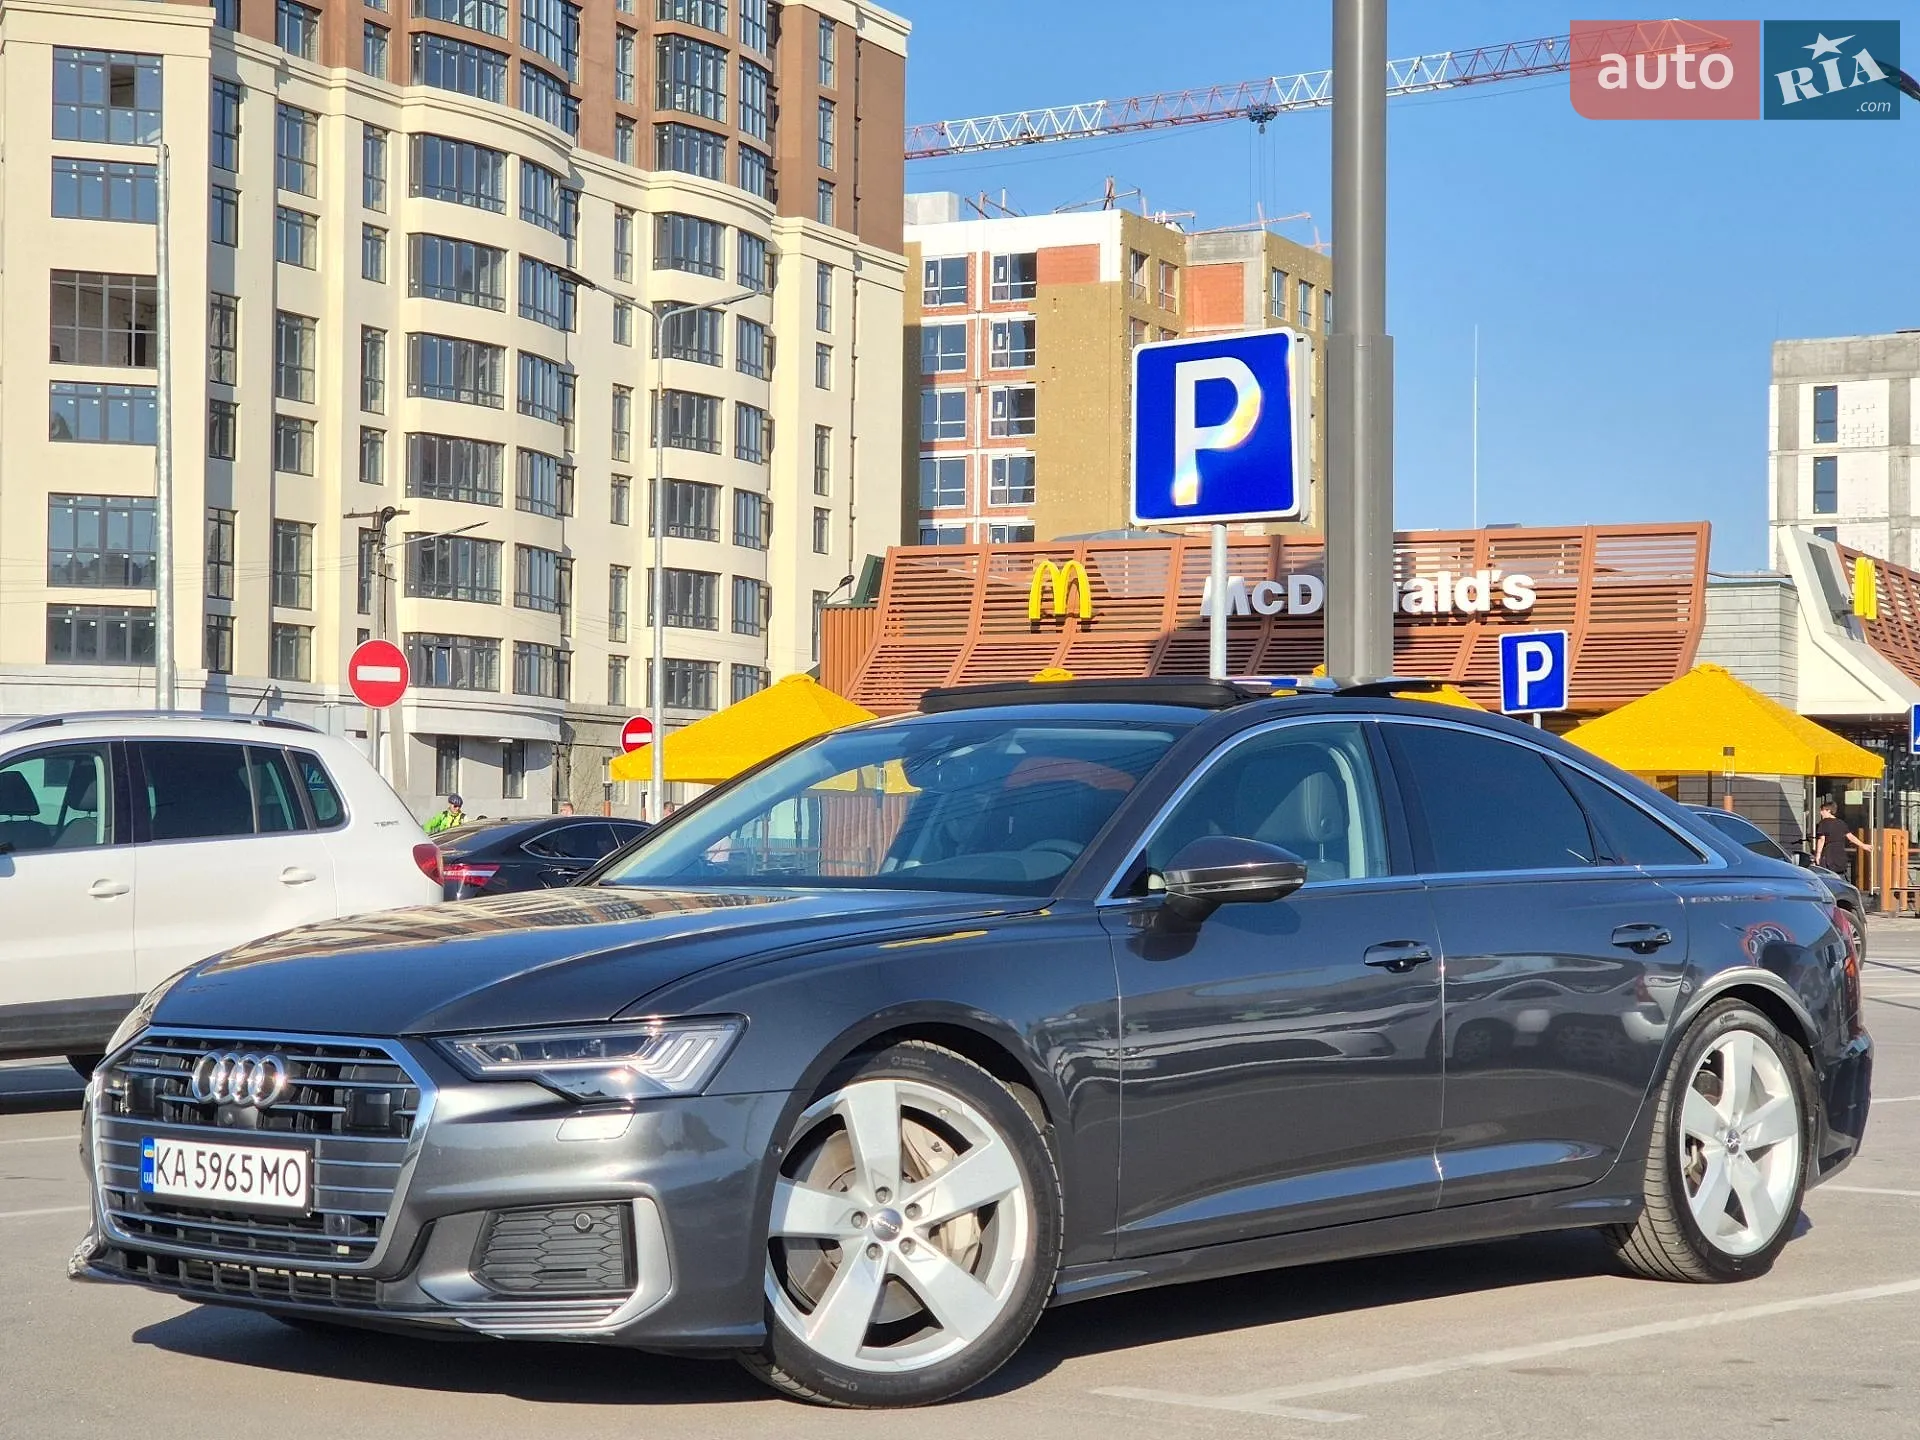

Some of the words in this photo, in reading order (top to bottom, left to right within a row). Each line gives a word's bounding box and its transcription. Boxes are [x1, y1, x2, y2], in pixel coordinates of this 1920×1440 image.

[1174, 356, 1262, 507] P
[1199, 570, 1537, 617] McDald's
[1517, 641, 1554, 706] P
[143, 1172, 154, 1185] UA
[155, 1146, 188, 1188] KA
[194, 1150, 254, 1194] 5965
[260, 1156, 302, 1198] MO
